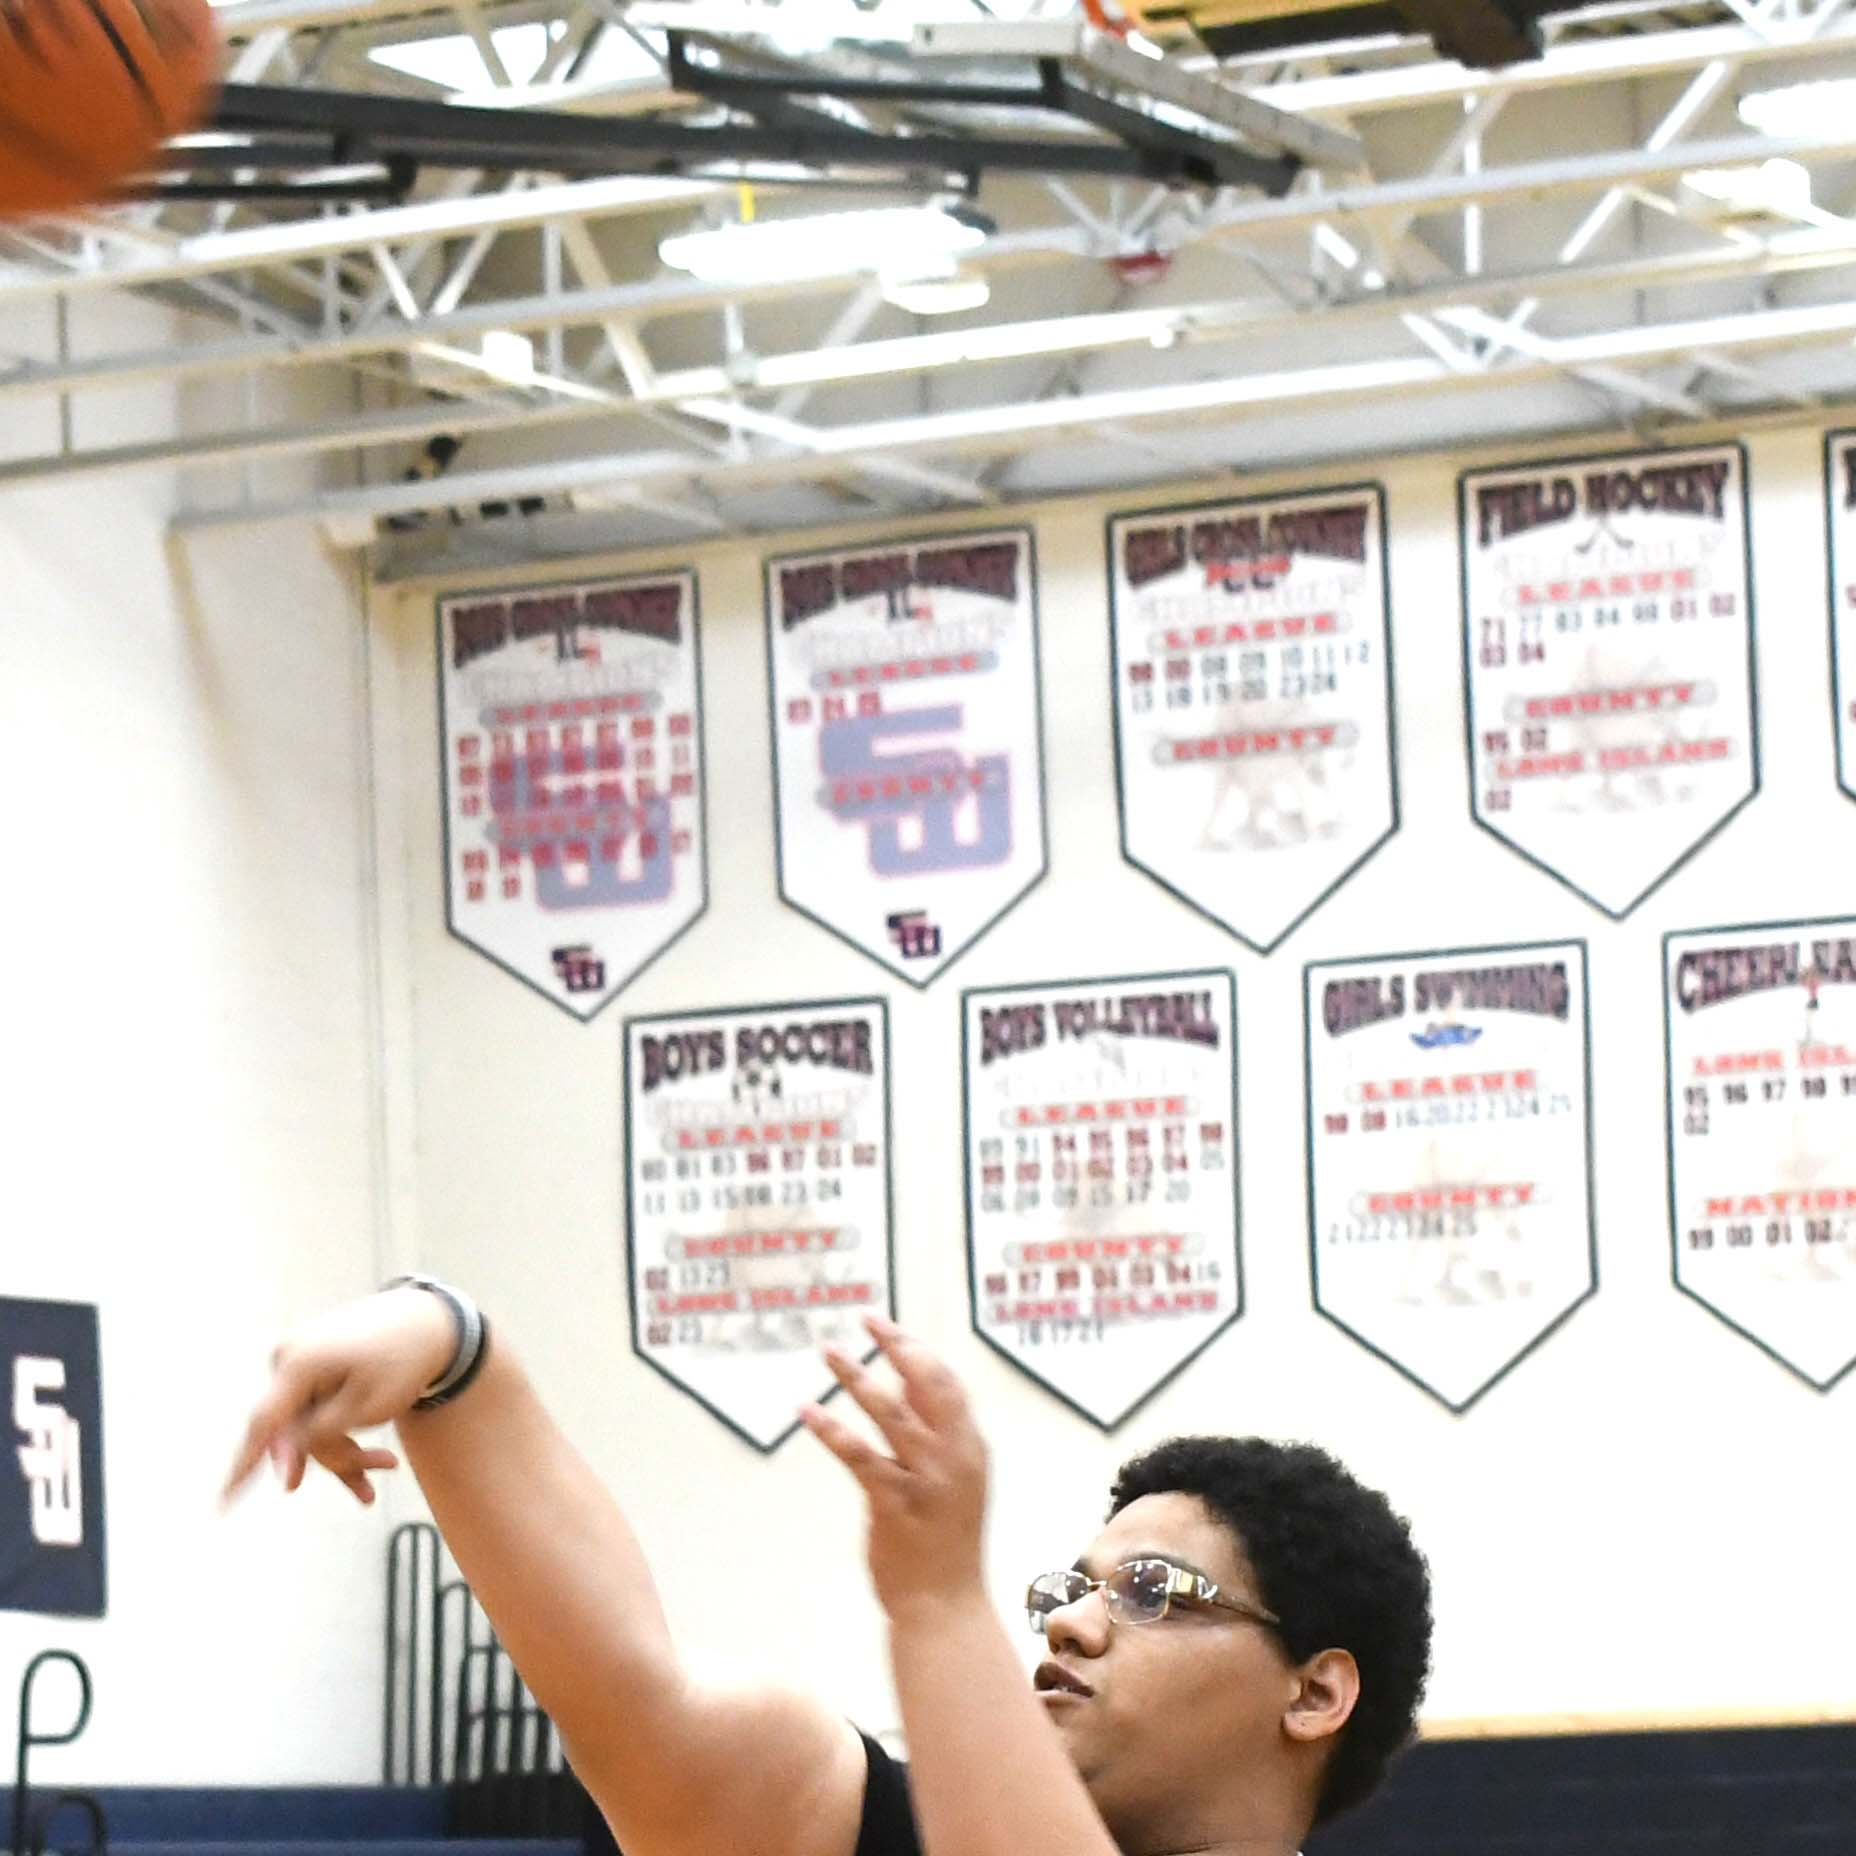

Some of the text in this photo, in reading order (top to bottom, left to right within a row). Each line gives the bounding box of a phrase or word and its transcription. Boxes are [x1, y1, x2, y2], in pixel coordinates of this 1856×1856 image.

[1583, 461, 1728, 520] HOCKEY
[1519, 569, 1692, 604] LEAGUE
[1165, 611, 1336, 649] LEAGUE
[1526, 683, 1692, 717] COUNTY
[1172, 725, 1335, 760] COUNTY
[642, 1019, 873, 1092] BOYS SOCCER
[1693, 1051, 1782, 1076] LONG
[1362, 1070, 1536, 1098] LEAGUE
[1018, 1098, 1183, 1125] LEAGUE
[678, 1121, 839, 1148] LEAGUE
[1369, 1183, 1534, 1213] COUNTY
[1023, 1236, 1182, 1262] COUNTY
